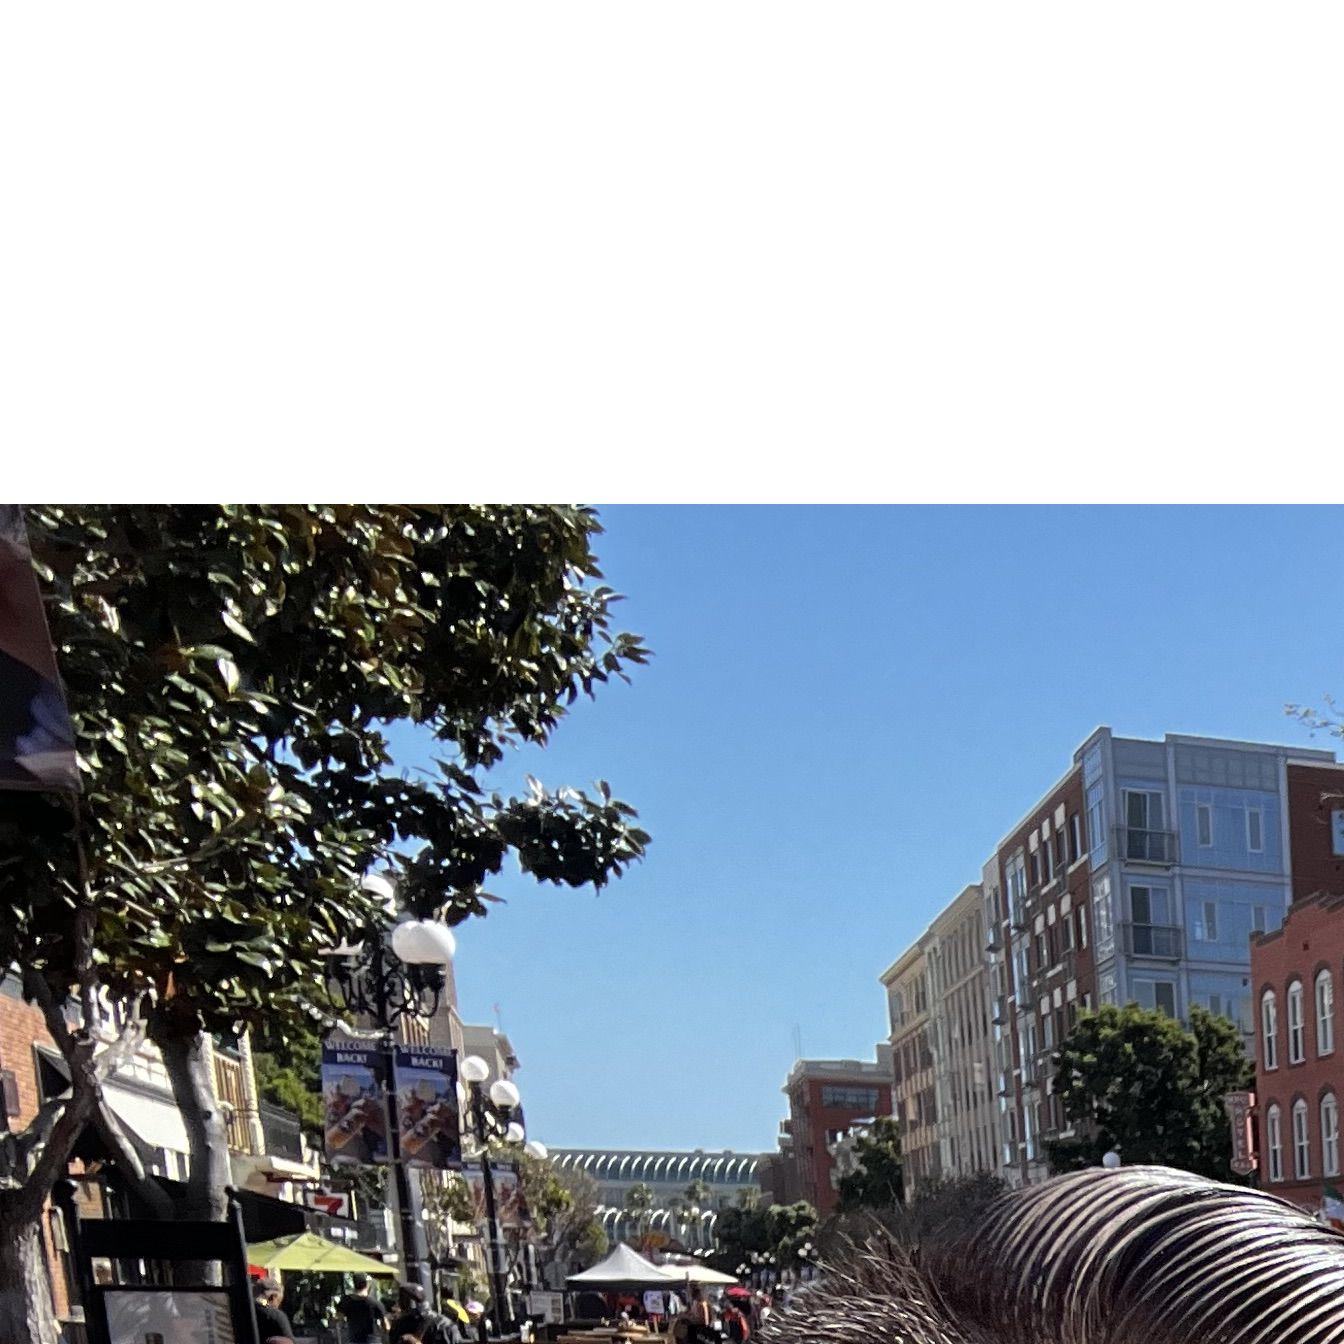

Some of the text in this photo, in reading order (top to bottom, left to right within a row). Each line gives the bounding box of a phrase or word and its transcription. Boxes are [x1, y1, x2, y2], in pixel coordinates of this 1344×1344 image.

[324, 1039, 378, 1051] WELCOME
[336, 1053, 368, 1064] BACK!
[410, 1056, 444, 1068] BACK!
